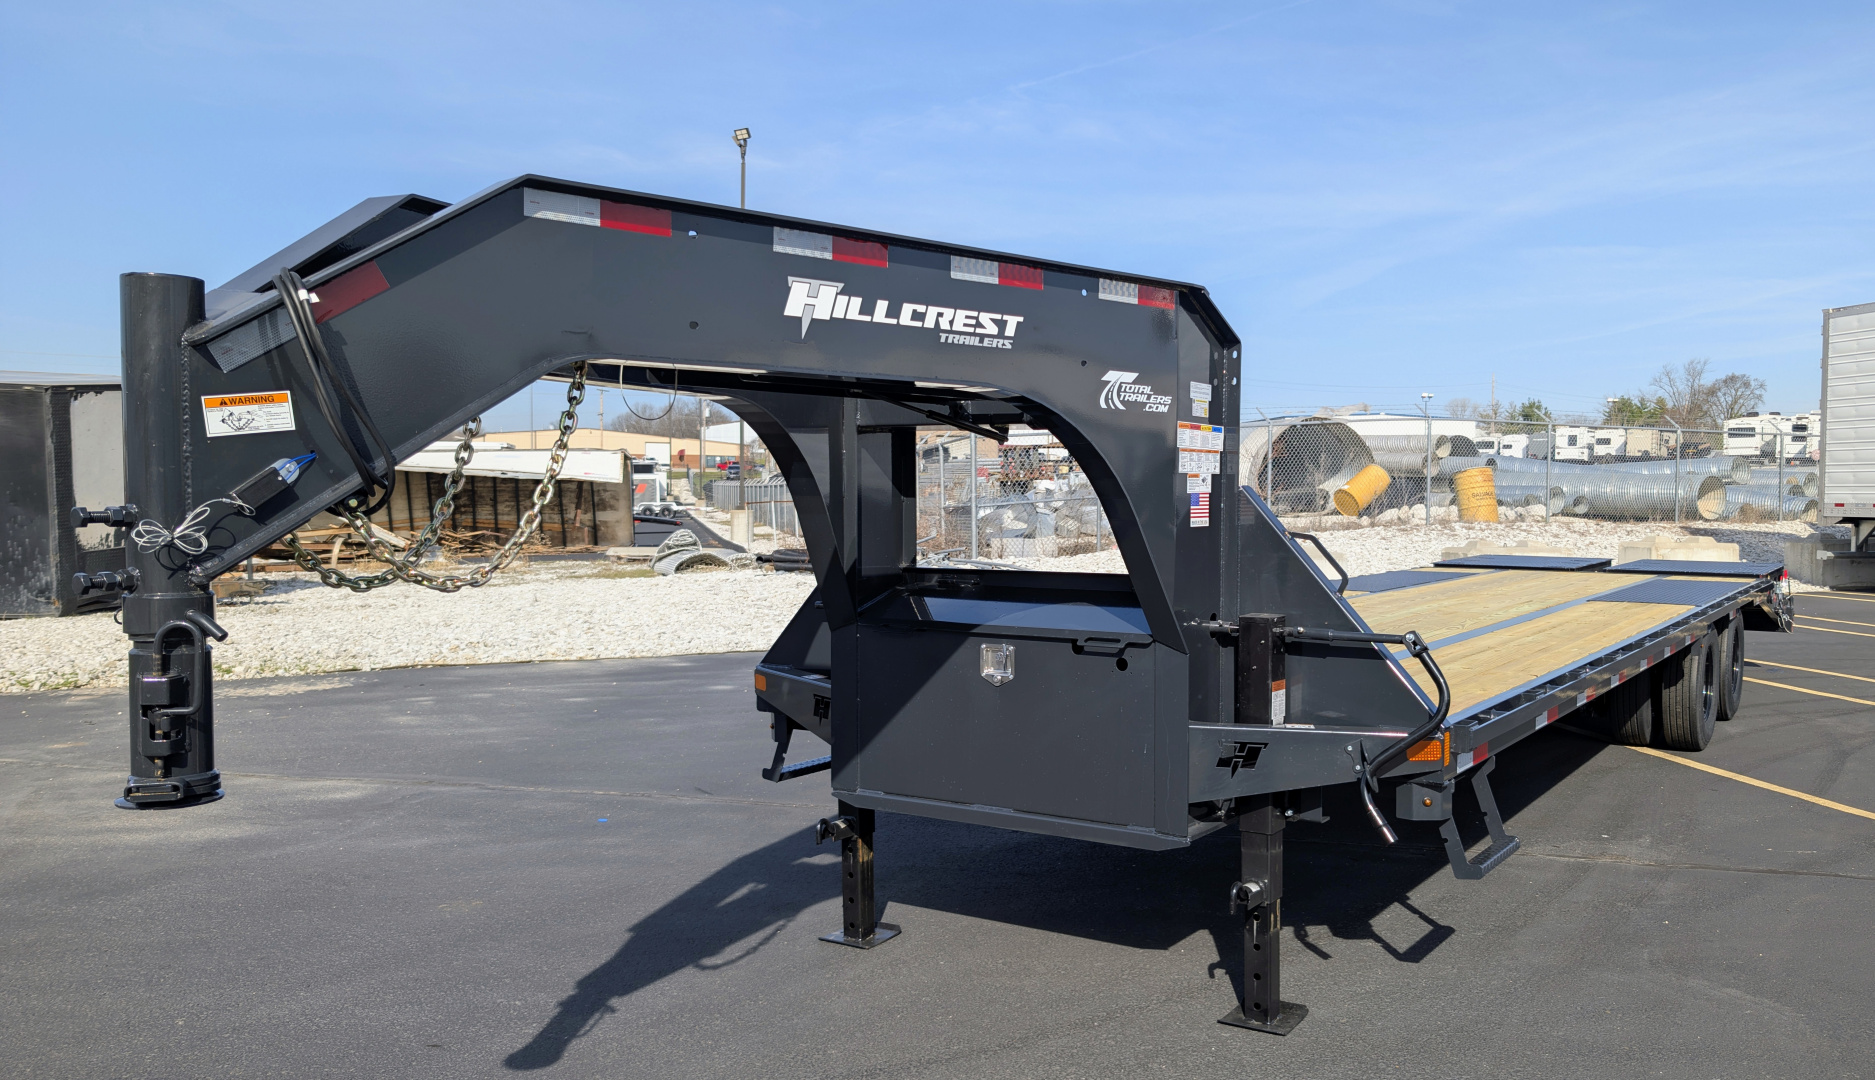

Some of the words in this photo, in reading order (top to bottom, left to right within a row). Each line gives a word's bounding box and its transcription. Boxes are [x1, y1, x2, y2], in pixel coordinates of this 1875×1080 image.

[783, 276, 1024, 338] HILLCREST
[939, 332, 1014, 350] TRAILERS
[1120, 383, 1154, 394] TOTAL
[228, 395, 275, 405] WARNING
[1119, 392, 1173, 405] TRAILERS
[1143, 403, 1169, 413] .COM
